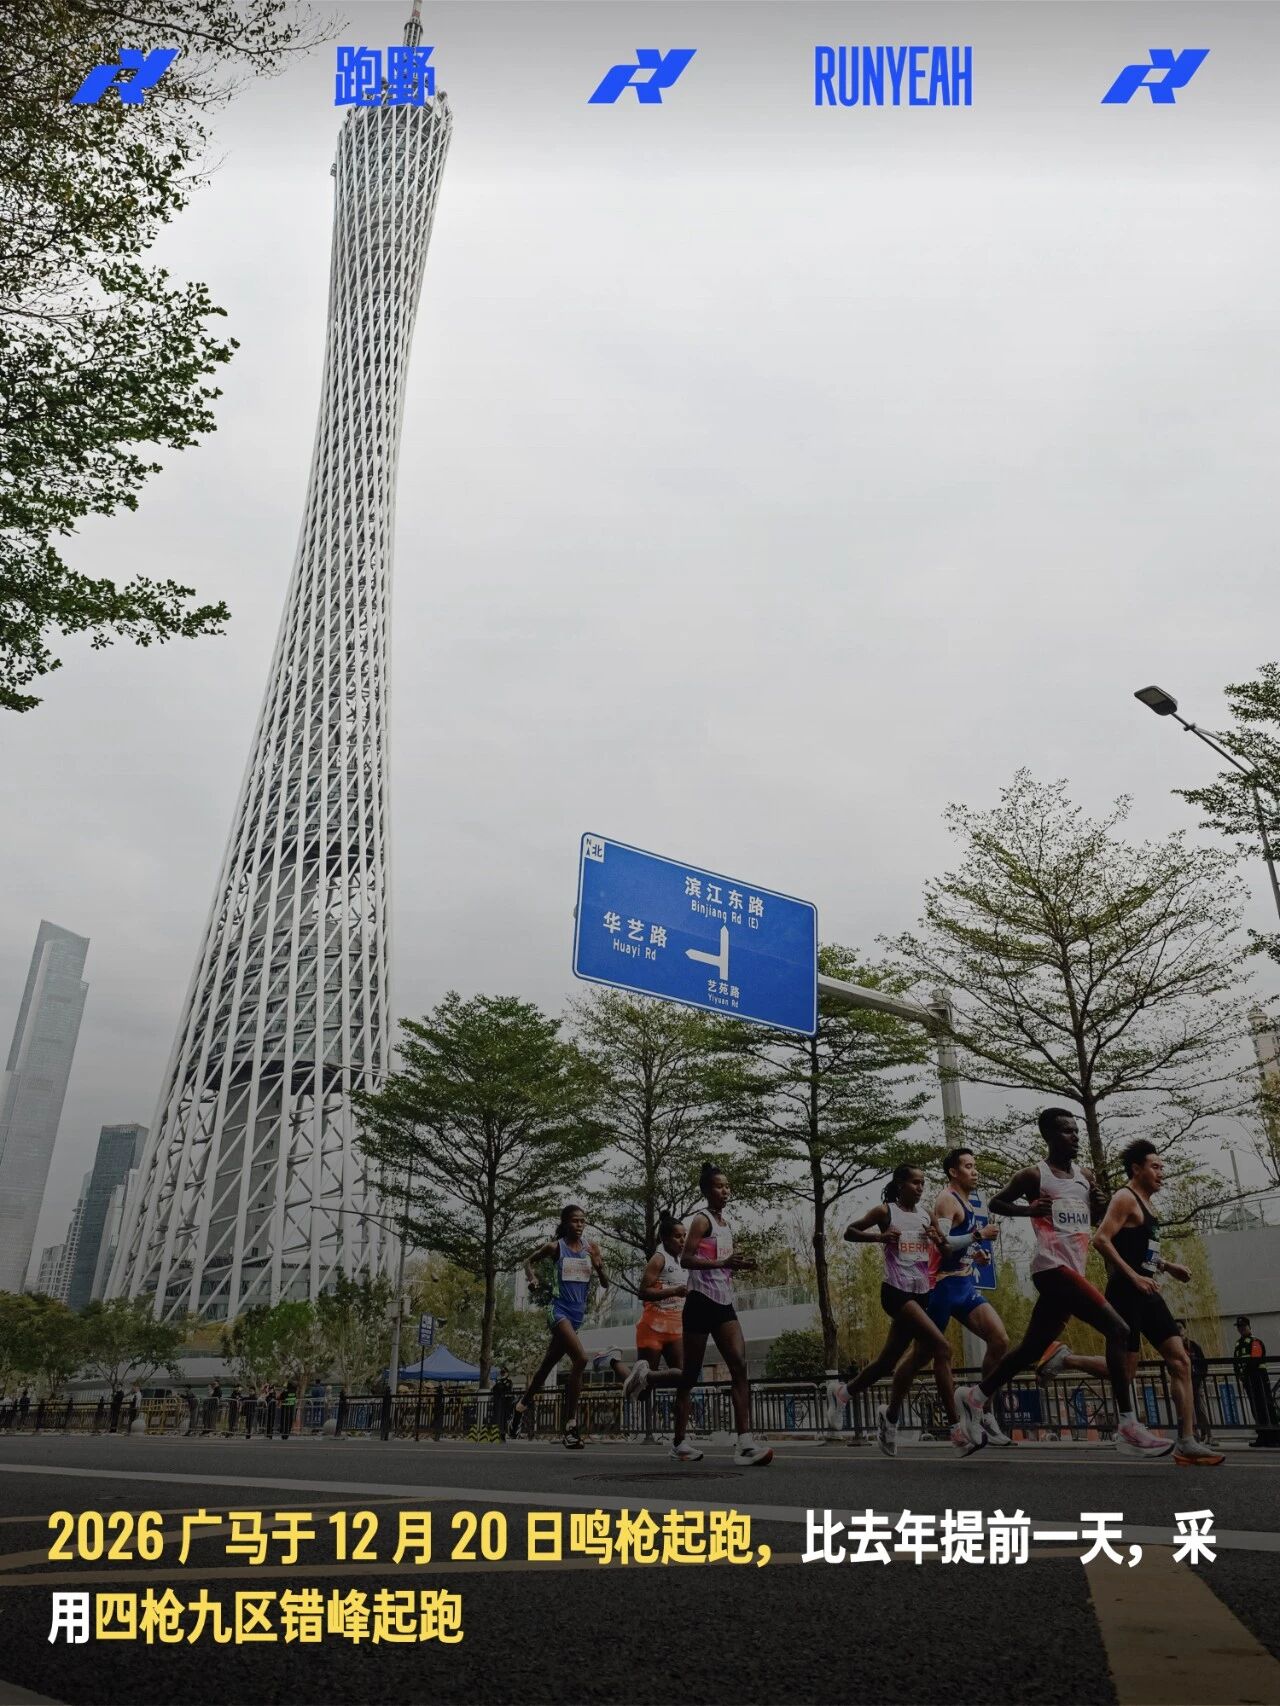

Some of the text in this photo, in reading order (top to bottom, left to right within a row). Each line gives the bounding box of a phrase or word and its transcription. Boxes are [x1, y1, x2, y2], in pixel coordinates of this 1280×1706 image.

[592, 844, 603, 857] 北
[685, 876, 764, 917] 滨江东路
[691, 900, 727, 923] Binjiang
[732, 912, 742, 925] Rd
[603, 911, 668, 948] 华艺路
[613, 939, 657, 961] Huayi Rd
[707, 979, 740, 998] 艺苑路
